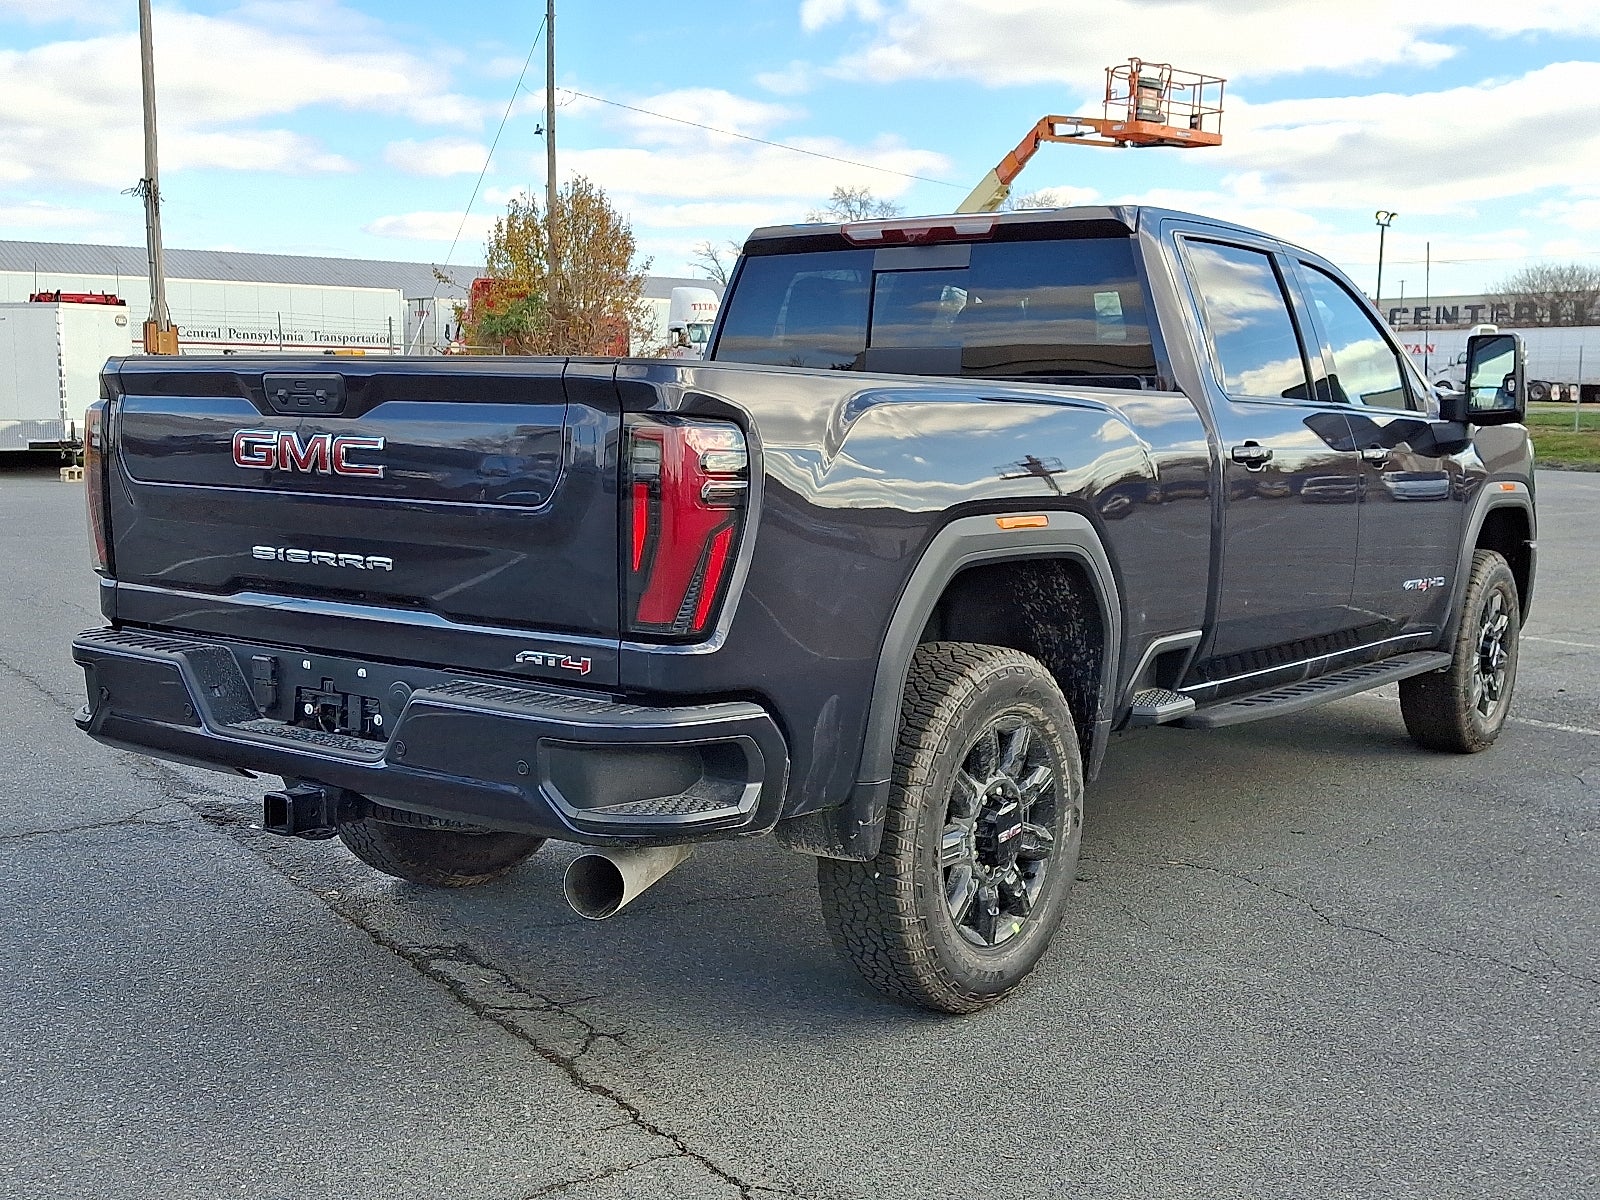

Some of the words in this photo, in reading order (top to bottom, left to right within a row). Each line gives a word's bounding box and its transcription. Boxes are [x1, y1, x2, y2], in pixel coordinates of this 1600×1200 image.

[1389, 301, 1563, 326] CENTRA
[177, 325, 222, 339] Central
[228, 327, 305, 343] Pennsylvania
[232, 428, 387, 480] GMC
[251, 545, 394, 572] SIERRA
[515, 650, 592, 676] AT4
